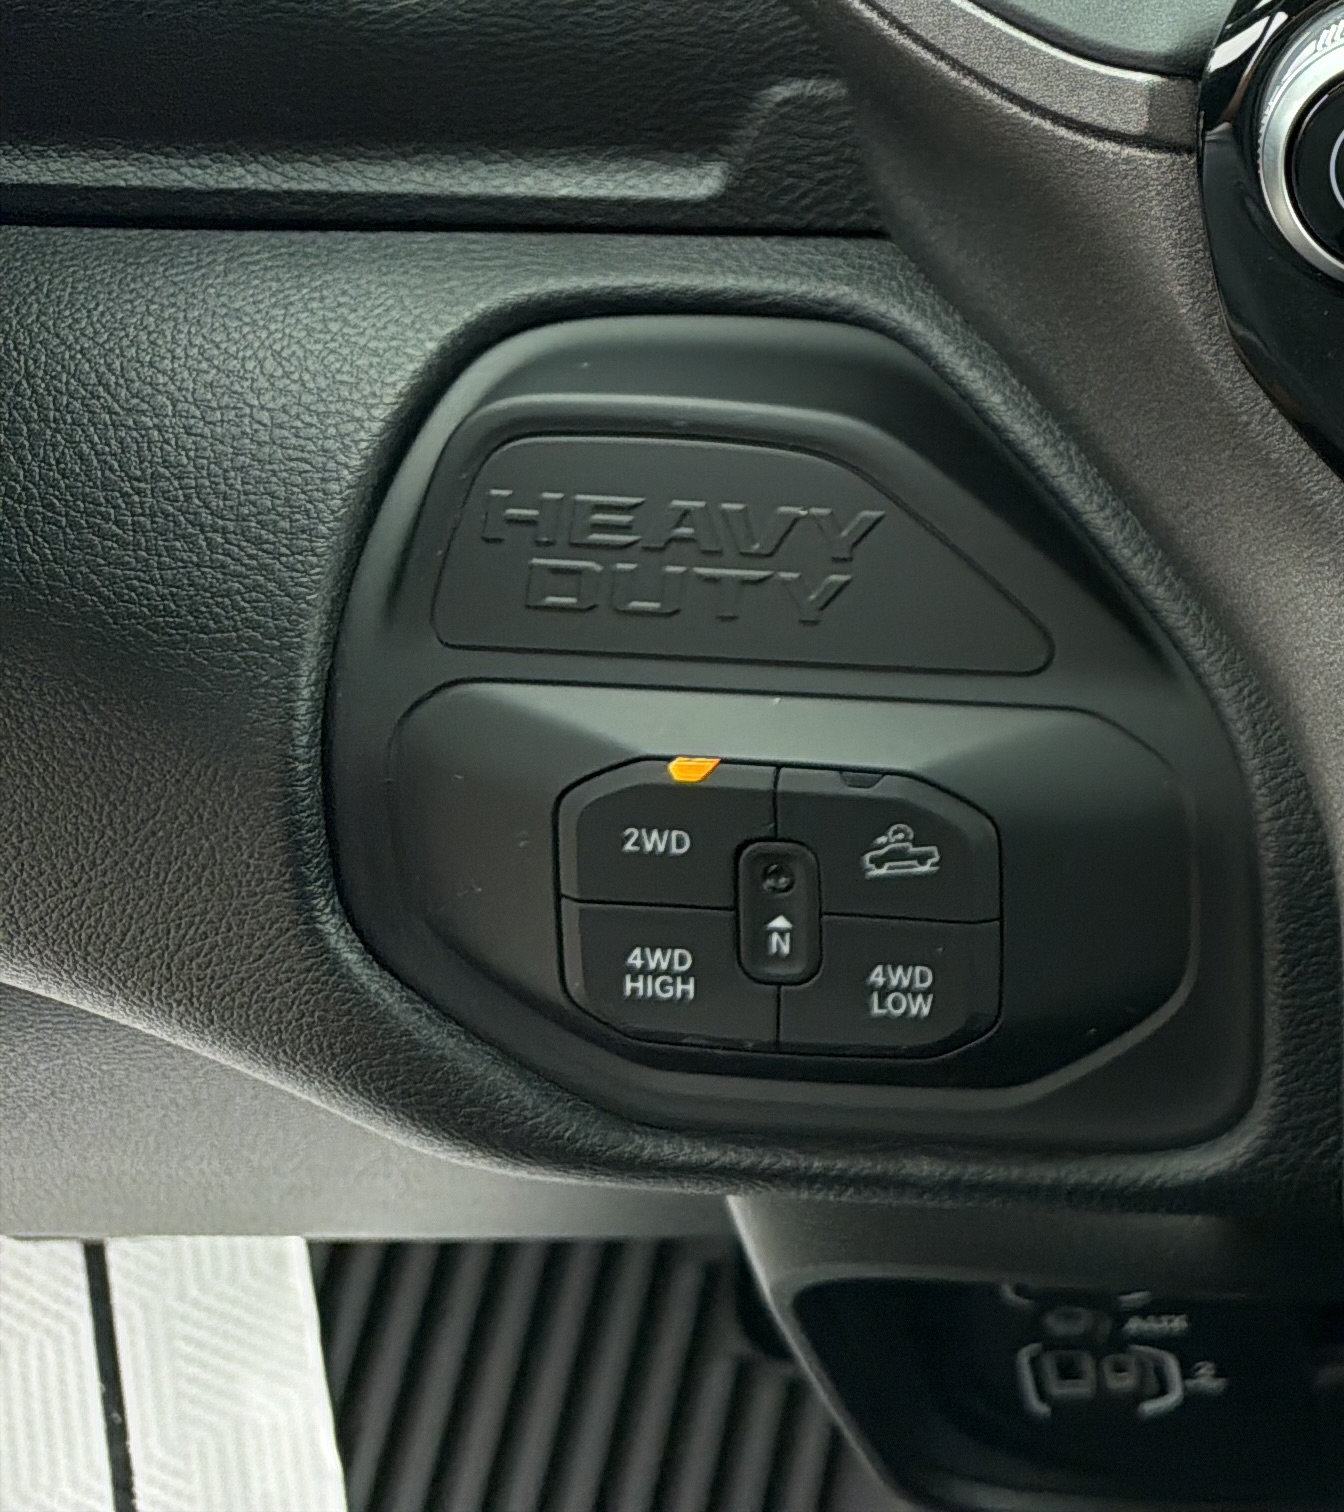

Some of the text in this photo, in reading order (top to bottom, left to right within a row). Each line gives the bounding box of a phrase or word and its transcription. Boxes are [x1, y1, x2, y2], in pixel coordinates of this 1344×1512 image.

[481, 489, 885, 561] HEAVY
[524, 558, 852, 625] DUTY
[622, 827, 692, 856] 2WD
[768, 932, 791, 956] N
[626, 947, 693, 972] 4WD
[624, 974, 696, 1001] HIGH
[867, 964, 934, 989] 4WD
[869, 991, 934, 1018] LOW
